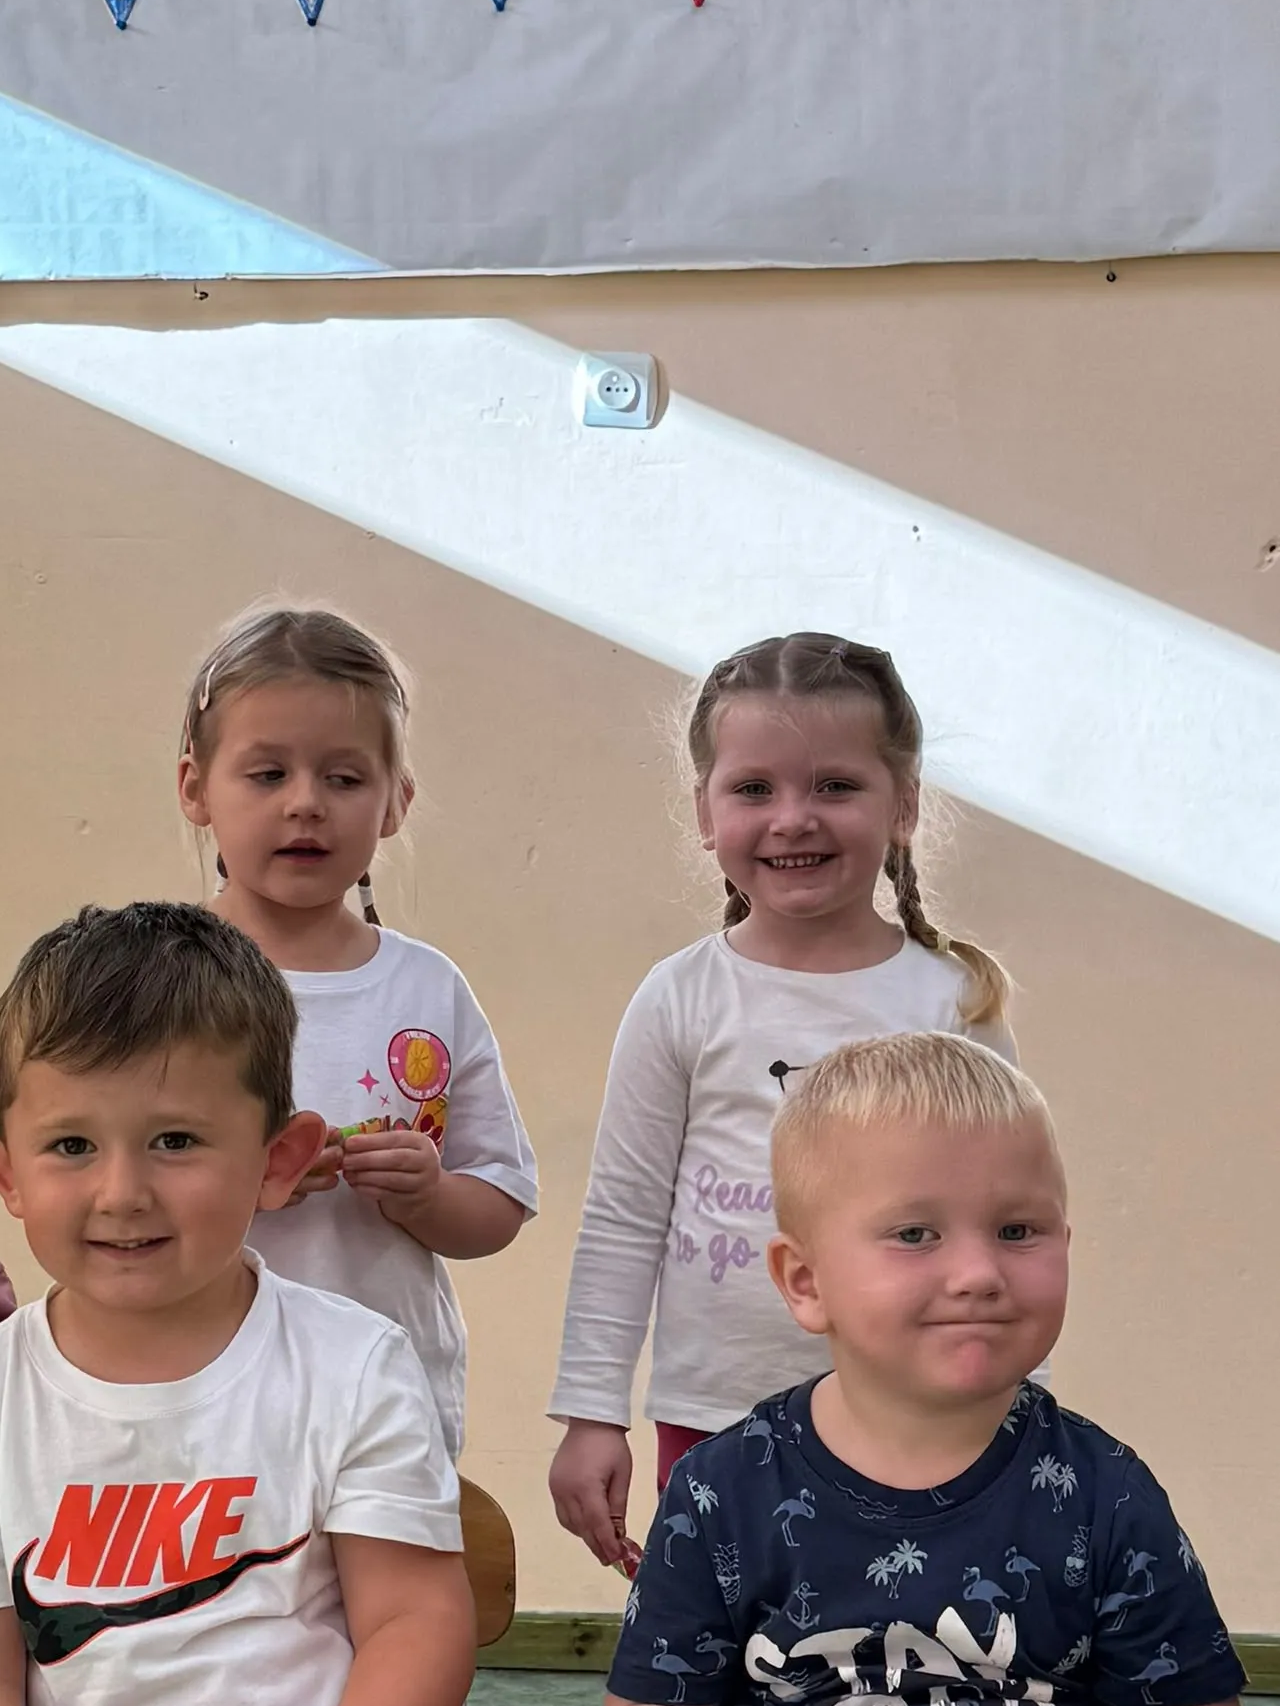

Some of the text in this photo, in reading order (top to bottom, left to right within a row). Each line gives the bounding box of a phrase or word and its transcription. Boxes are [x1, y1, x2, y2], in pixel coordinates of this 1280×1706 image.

[694, 1164, 773, 1212] Rea
[708, 1233, 760, 1284] go
[33, 1476, 258, 1588] NIKE
[745, 1606, 1017, 1703] STAY
